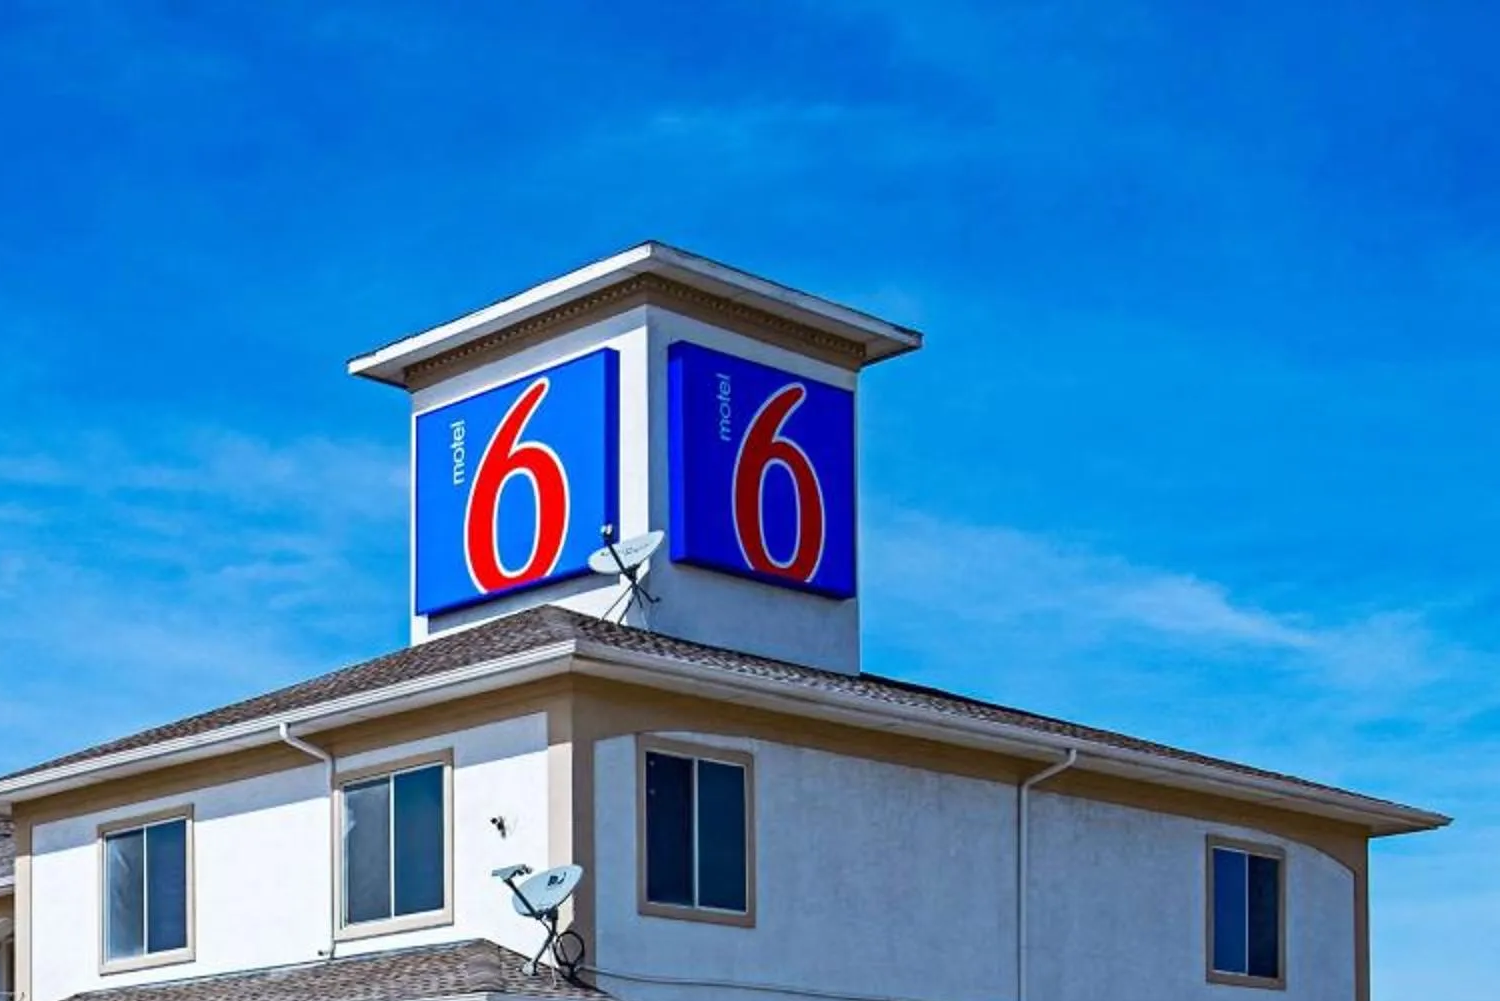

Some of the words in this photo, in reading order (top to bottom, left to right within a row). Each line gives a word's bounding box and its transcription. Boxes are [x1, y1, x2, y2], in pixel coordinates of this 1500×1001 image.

[450, 420, 466, 485] motel
[717, 373, 731, 441] motel
[464, 378, 570, 594] 6
[732, 383, 825, 583] 6
